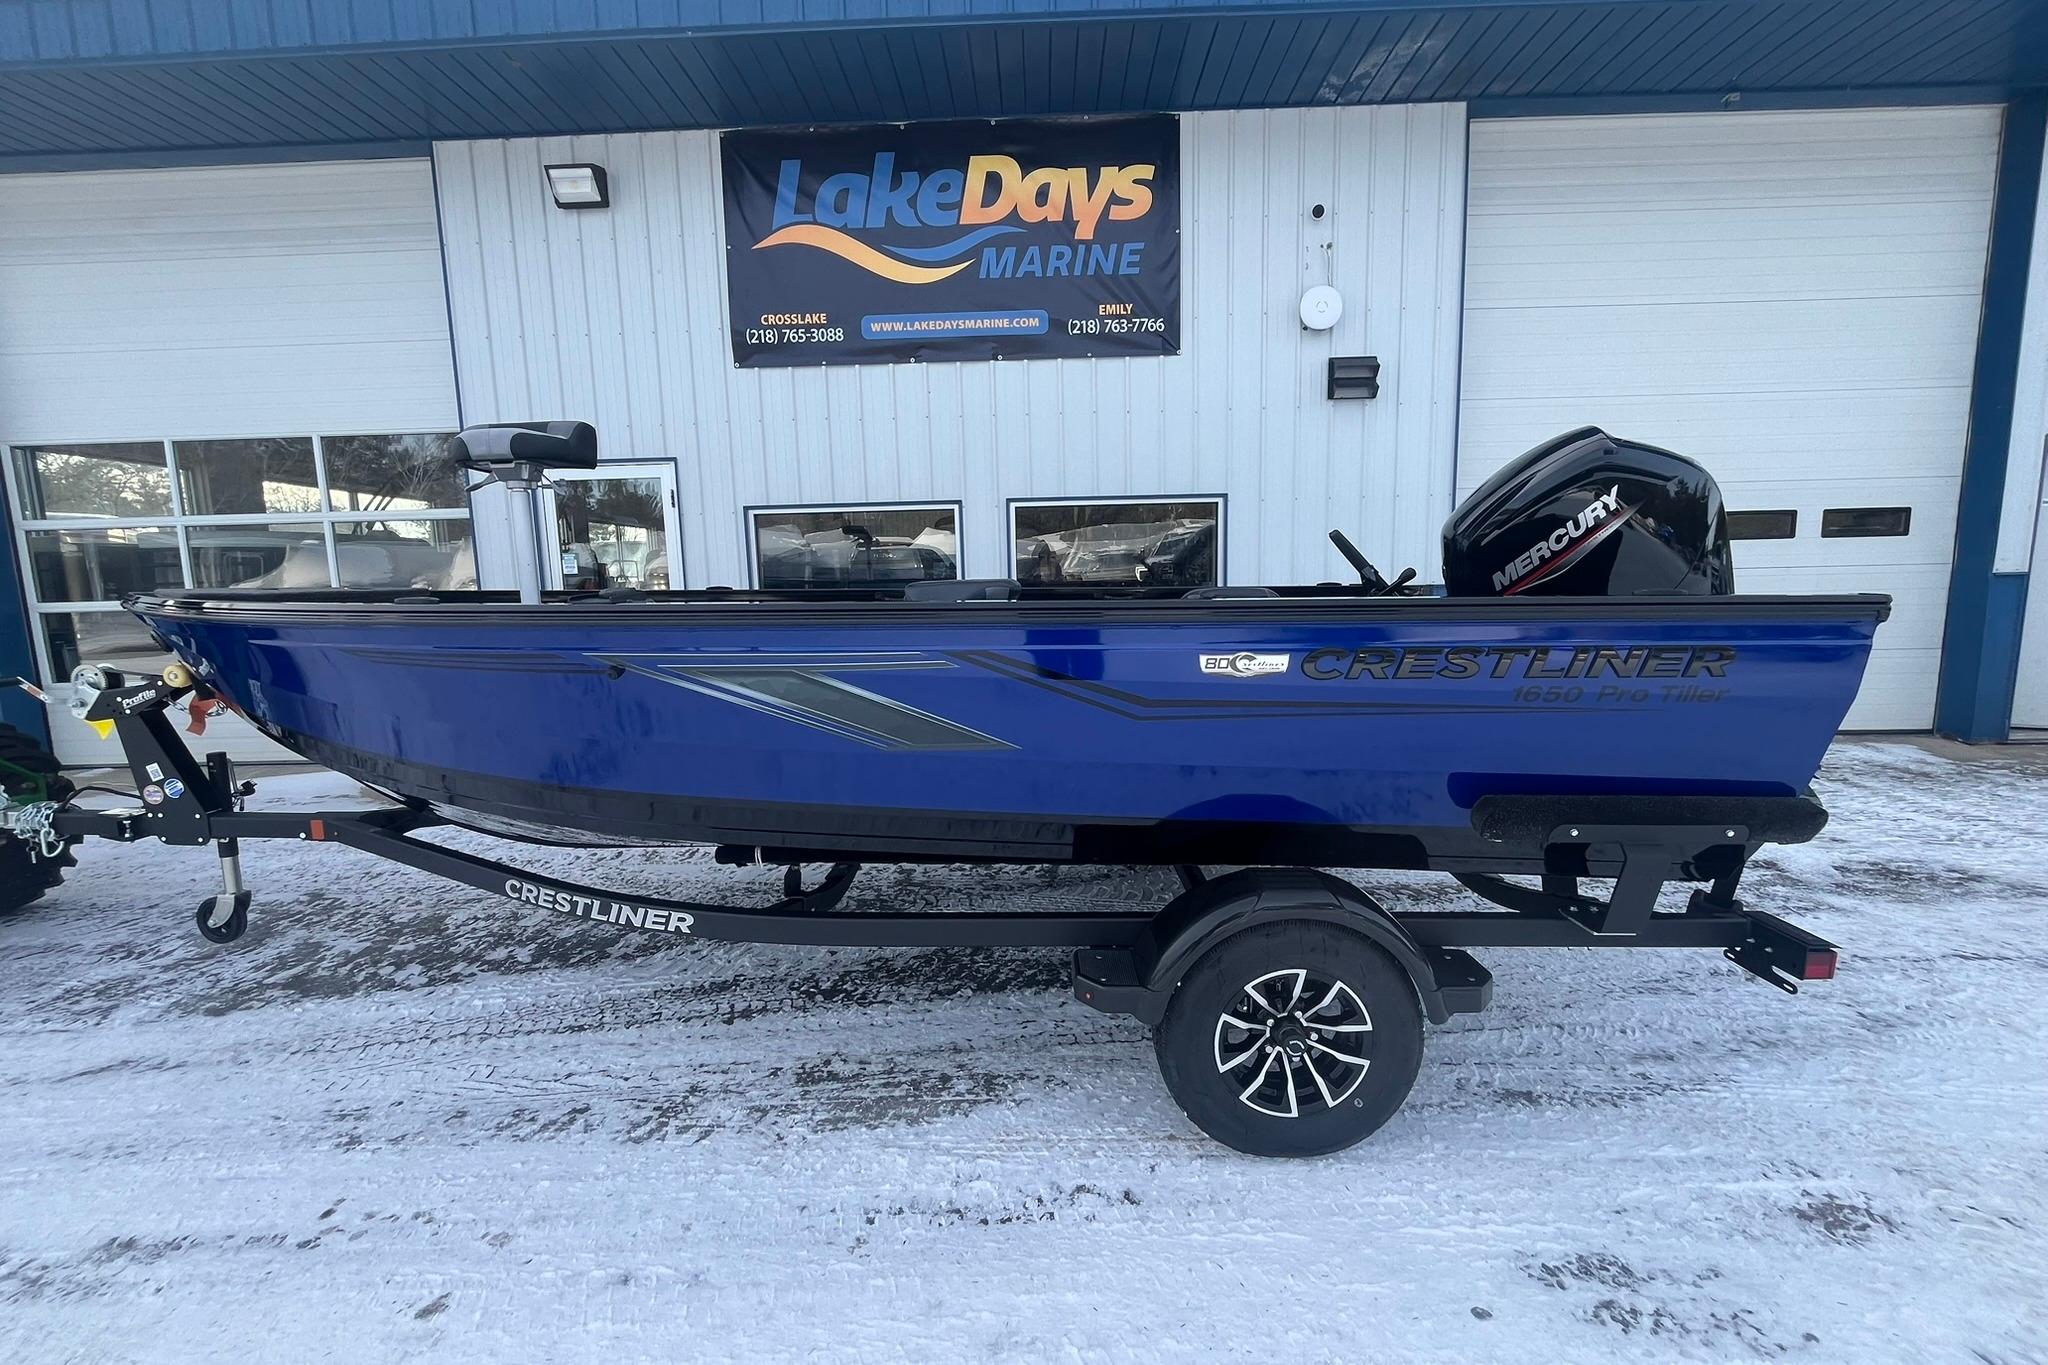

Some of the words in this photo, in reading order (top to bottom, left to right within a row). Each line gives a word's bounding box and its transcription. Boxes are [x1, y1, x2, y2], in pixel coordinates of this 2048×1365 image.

[979, 242, 1145, 280] MARINE
[760, 313, 828, 325] CROSSLAKE
[1099, 303, 1134, 316] EMILY
[870, 317, 1040, 333] WWW.LAKEDAYSMARINE.COM
[1068, 319, 1101, 336] (218)
[1104, 317, 1165, 334] 763-7766
[746, 328, 779, 345] (218)
[781, 327, 845, 343] 765-3088
[1491, 484, 1620, 592] MERCURY
[1205, 657, 1230, 670] 80
[1299, 646, 1736, 680] CRESTLINER
[1512, 685, 1584, 704] 1650
[1598, 685, 1650, 703] Pro
[1661, 684, 1731, 704] Tiller
[504, 879, 695, 934] CRESTLINER
